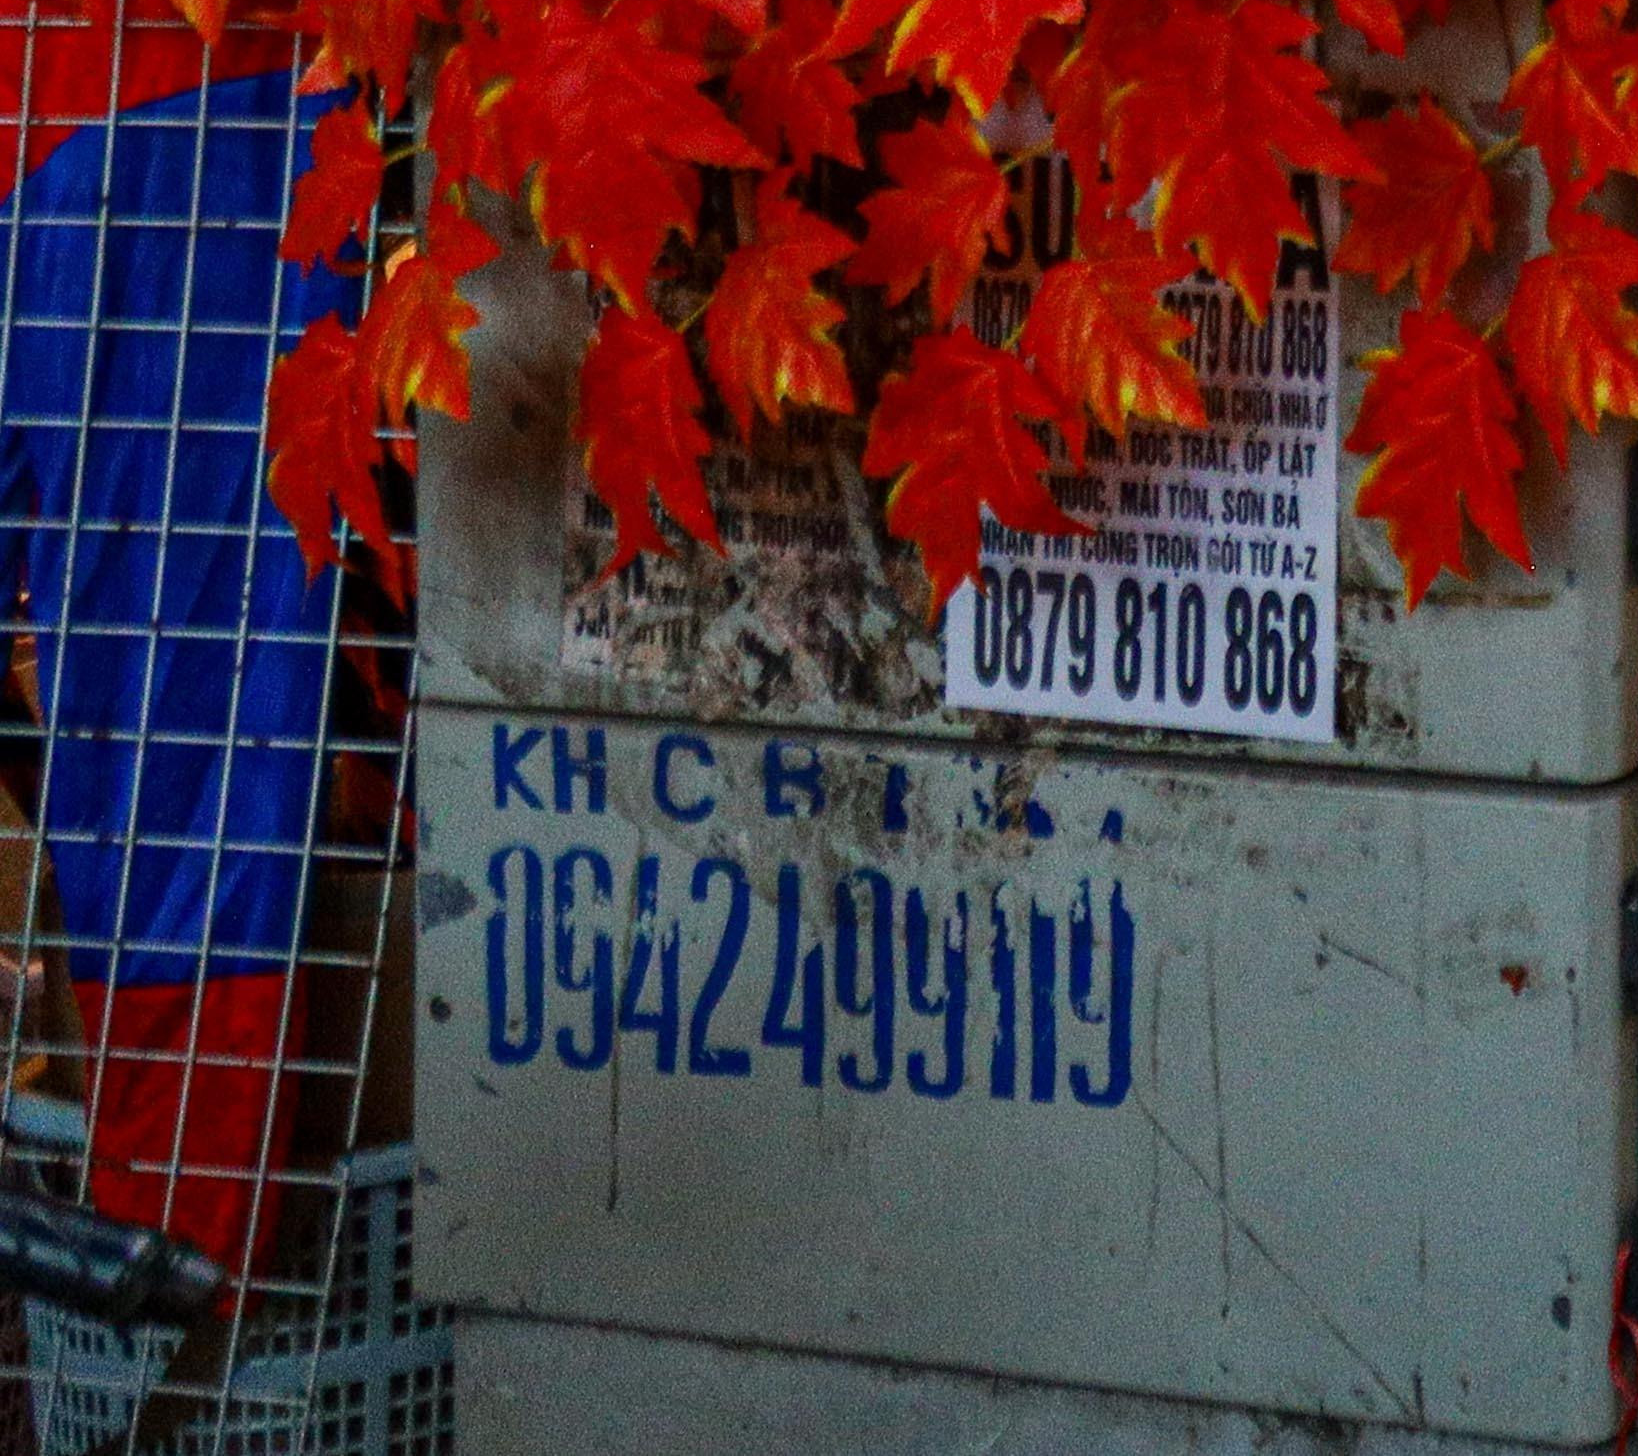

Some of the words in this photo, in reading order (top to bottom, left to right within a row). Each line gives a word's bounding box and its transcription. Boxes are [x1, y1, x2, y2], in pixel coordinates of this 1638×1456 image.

[1281, 299, 1329, 382] 868
[1222, 485, 1265, 526] SƠN
[1272, 479, 1301, 530] BẢ
[1144, 532, 1200, 577] TRỌN
[1206, 528, 1243, 574] GÓI
[1249, 534, 1278, 579] TỪ
[1281, 545, 1318, 582] A-Z
[974, 566, 1097, 698] 0879
[1113, 578, 1207, 709] 810
[1223, 586, 1318, 719] 868
[485, 841, 1136, 1109] 0942499119
